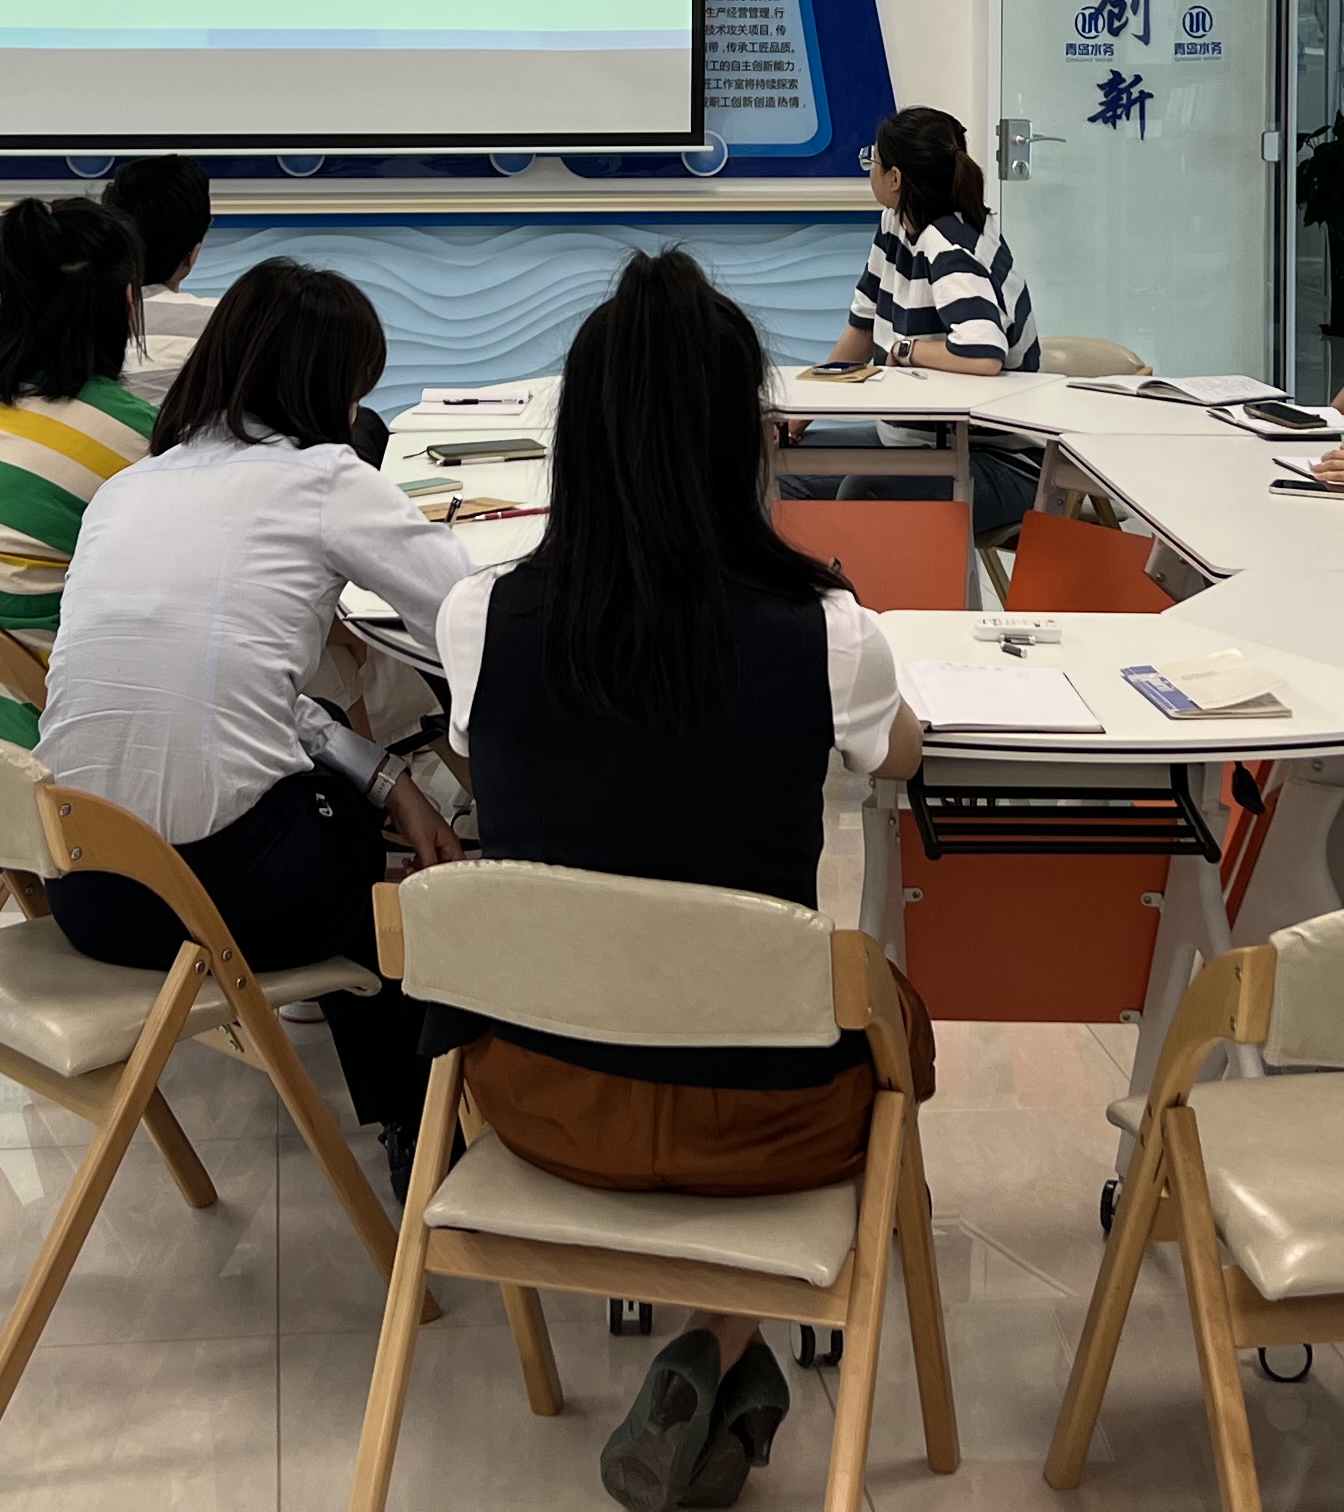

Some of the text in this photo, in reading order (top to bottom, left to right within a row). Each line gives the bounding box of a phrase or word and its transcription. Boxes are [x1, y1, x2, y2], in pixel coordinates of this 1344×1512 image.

[1066, 43, 1115, 56] 青岛水务
[1174, 42, 1223, 56] 青岛水务
